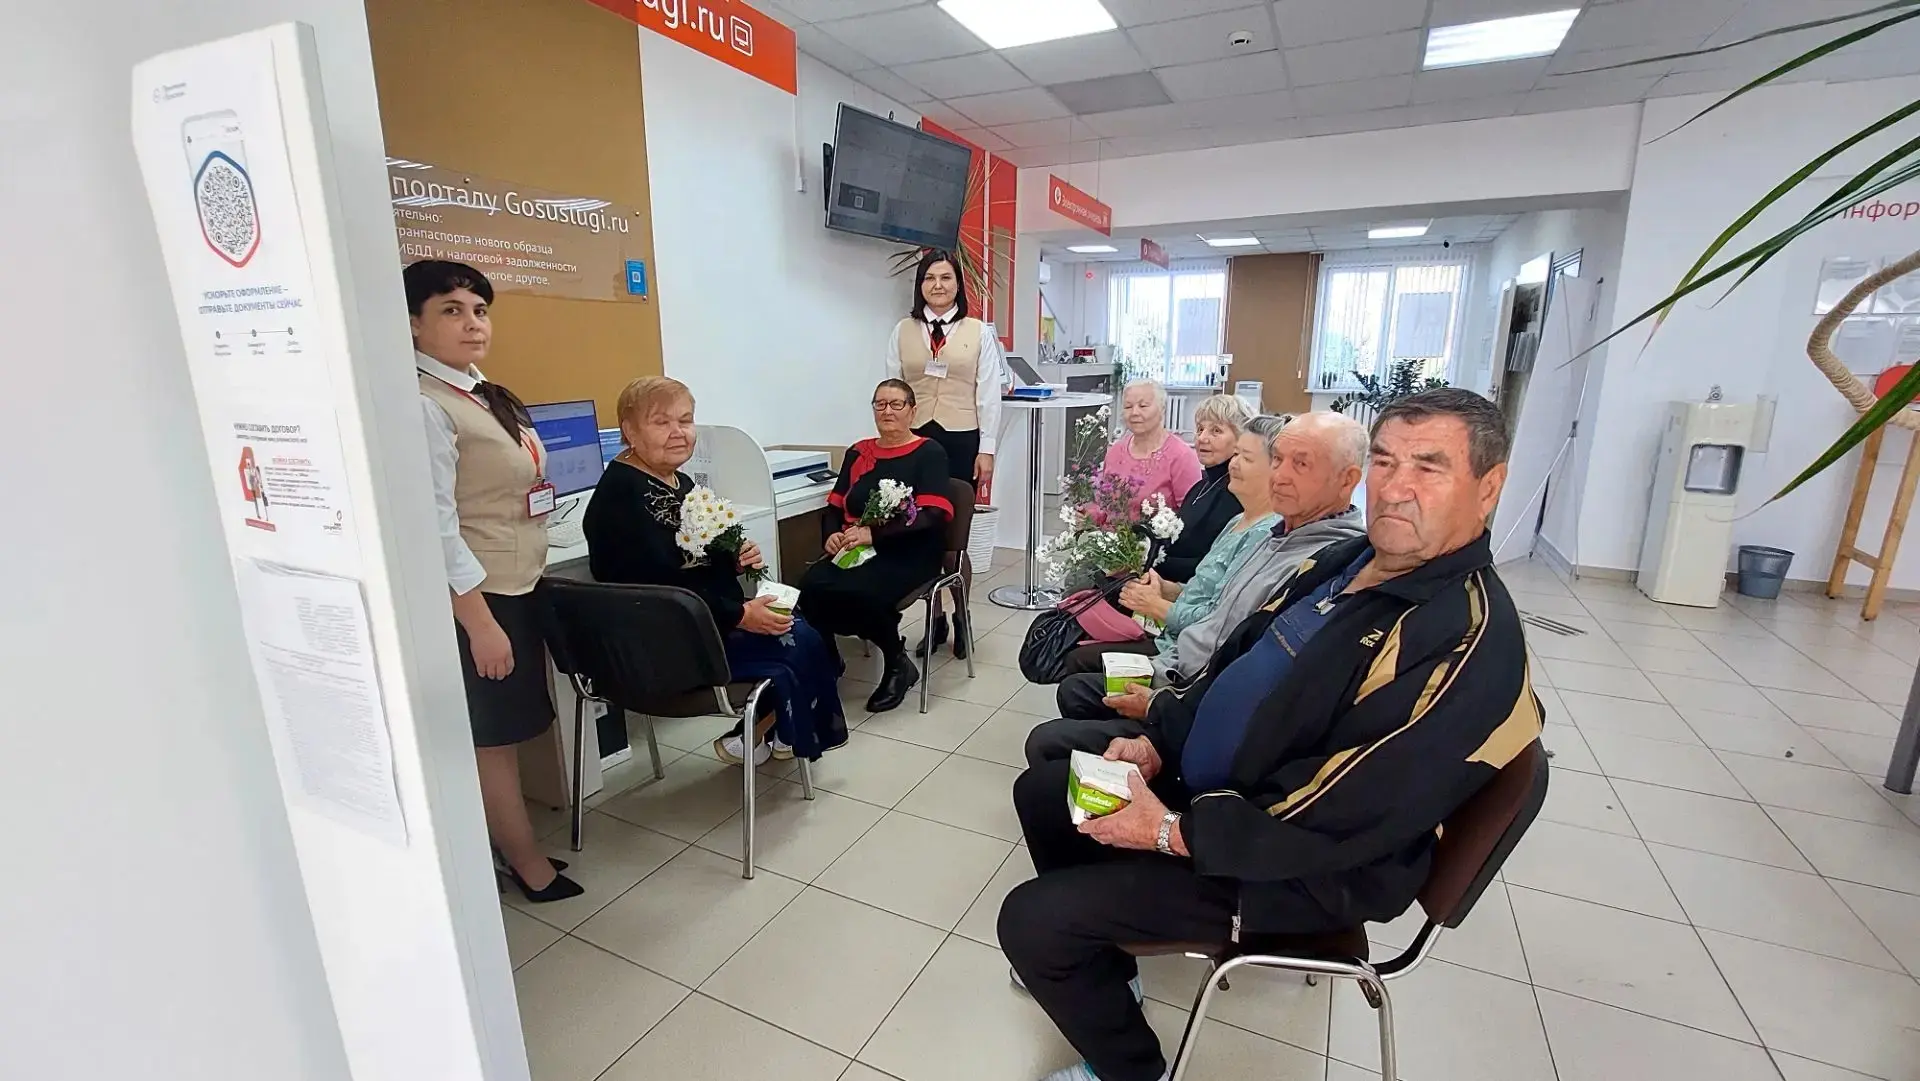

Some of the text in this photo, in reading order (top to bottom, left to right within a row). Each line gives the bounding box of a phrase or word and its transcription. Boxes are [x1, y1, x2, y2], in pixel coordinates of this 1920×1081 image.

[392, 176, 629, 233] порталу Gosuslugi.ru
[1832, 199, 1920, 223] нфор
[474, 235, 511, 249] нового
[513, 241, 553, 255] образца
[436, 250, 444, 258] и
[447, 251, 503, 265] налоговой
[505, 256, 577, 273] задолженности
[481, 271, 551, 286] ногое другое.
